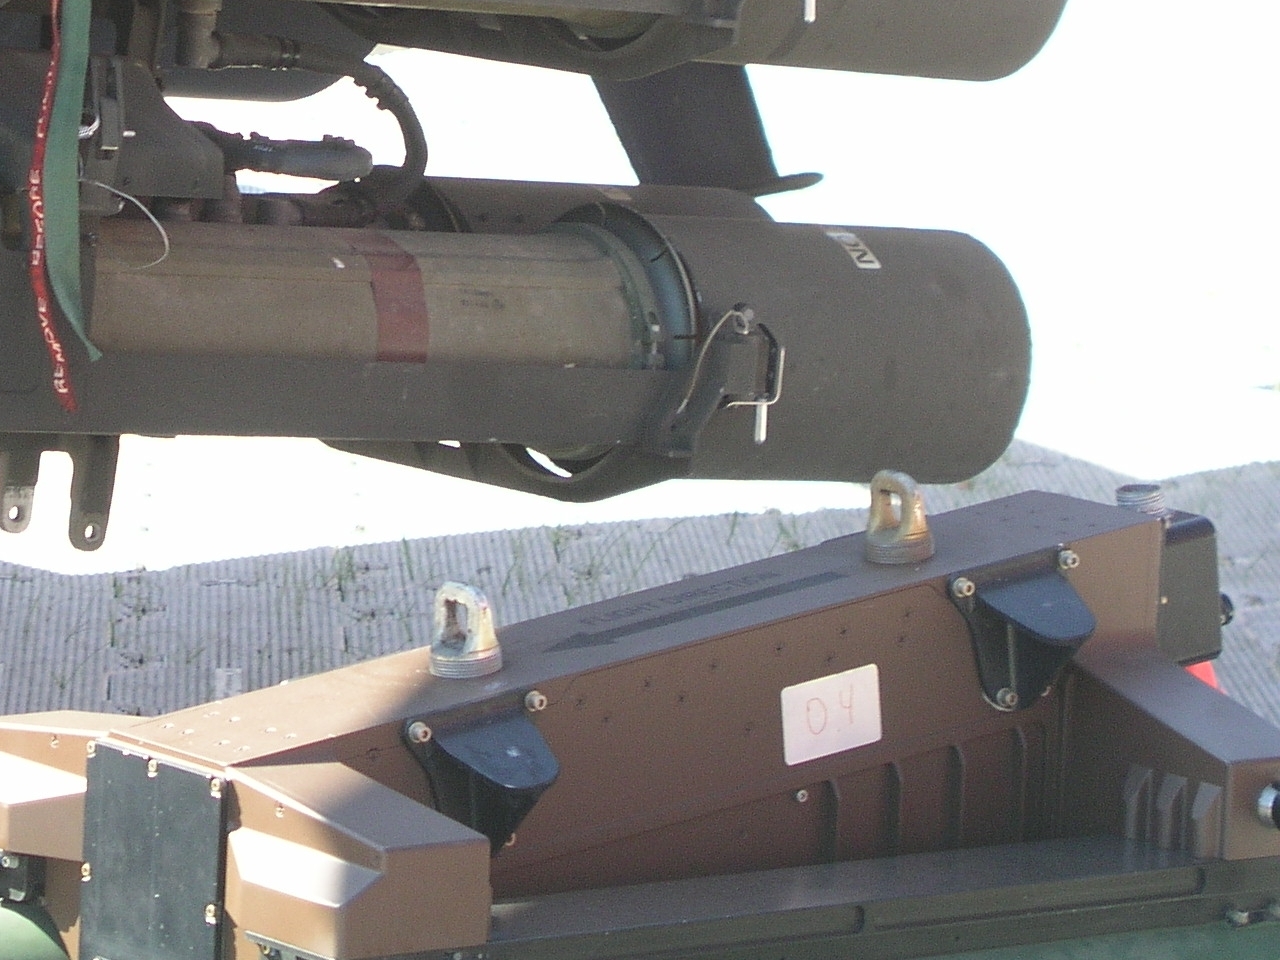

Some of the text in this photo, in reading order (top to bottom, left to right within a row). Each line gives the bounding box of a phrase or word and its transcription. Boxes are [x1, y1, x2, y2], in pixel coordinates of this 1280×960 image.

[37, 296, 68, 393] REMOVE
[578, 572, 781, 626] FLIGHT DIRECTION
